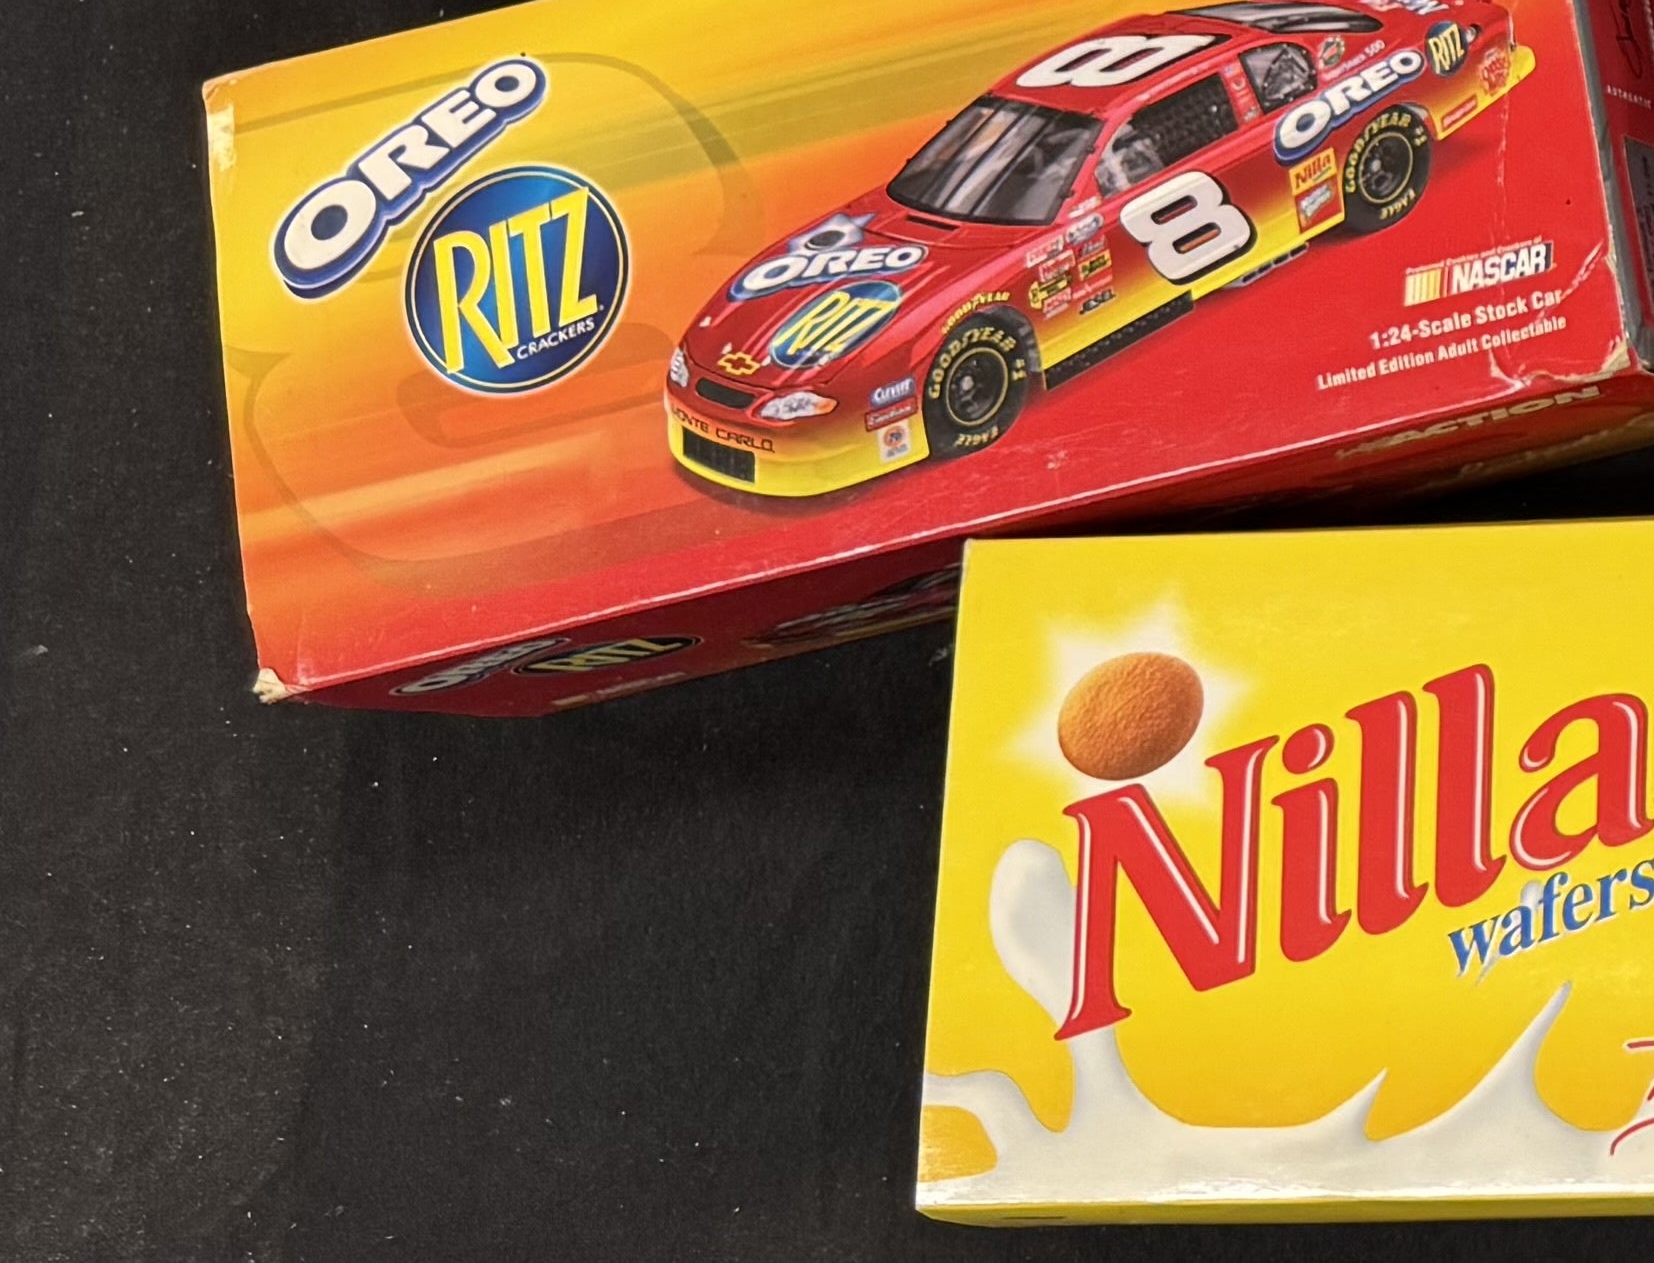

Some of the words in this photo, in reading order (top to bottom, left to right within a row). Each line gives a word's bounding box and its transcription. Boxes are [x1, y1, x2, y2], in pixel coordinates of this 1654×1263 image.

[1016, 35, 1231, 88] 8
[1428, 23, 1465, 75] RITZ
[1278, 51, 1424, 151] OREO
[283, 59, 538, 272] OREO
[1293, 153, 1332, 189] Nilla
[1120, 171, 1257, 286] 8
[433, 187, 599, 375] RITZ
[742, 246, 923, 294] OREO
[1451, 244, 1547, 295] NASCAR
[516, 316, 595, 361] CRACKERS
[783, 290, 890, 355] RITZ
[1369, 312, 1472, 350] 1:24-Scale
[1474, 297, 1528, 326] Stock
[1531, 289, 1563, 310] Car
[1317, 360, 1376, 390] Limited
[1378, 351, 1434, 376] Edition
[1438, 339, 1478, 360] Adult
[1481, 315, 1566, 350] Collectable
